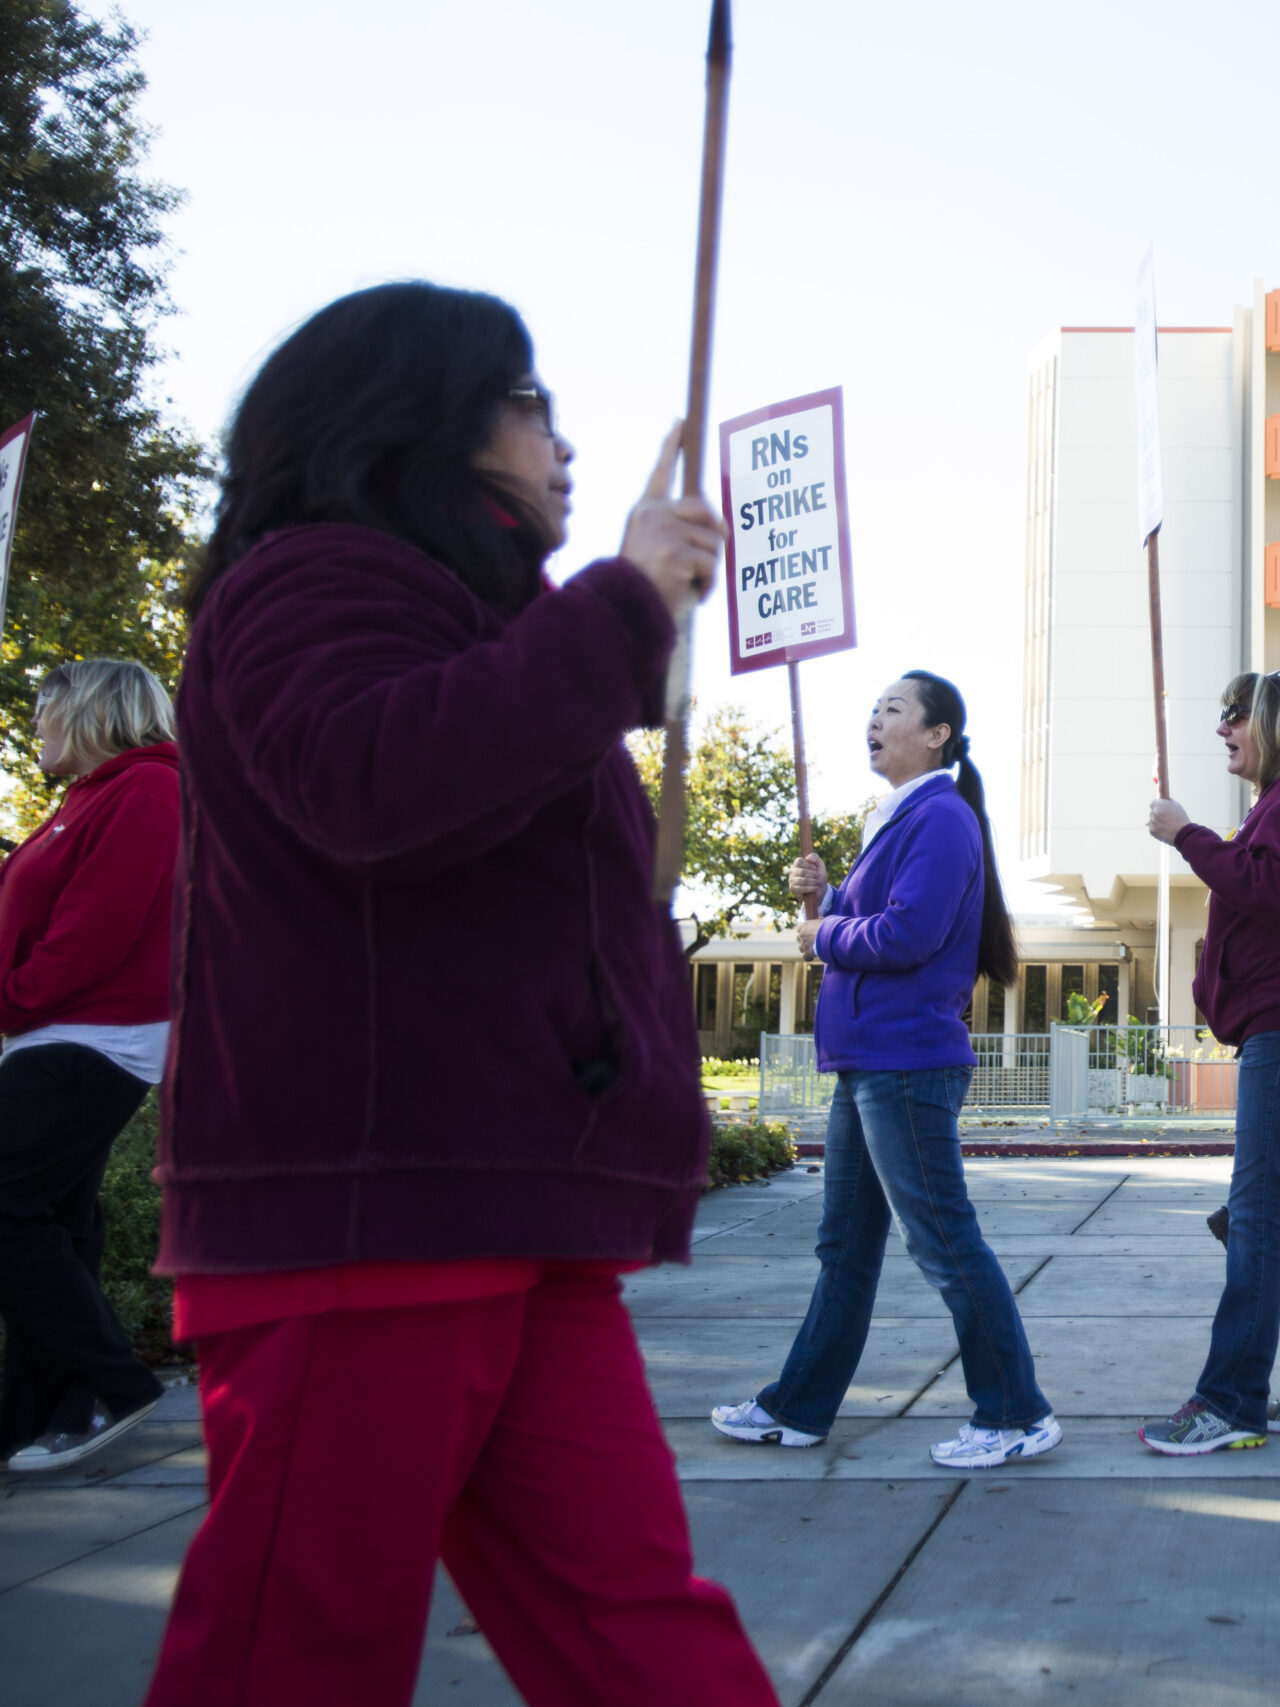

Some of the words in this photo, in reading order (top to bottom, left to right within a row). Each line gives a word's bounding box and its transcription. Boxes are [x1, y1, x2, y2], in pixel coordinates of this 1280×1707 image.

[752, 429, 809, 471] RNs
[767, 468, 791, 488] on
[740, 481, 827, 531] STRIKE
[768, 528, 797, 552] for
[741, 544, 832, 592] PATIENT
[758, 581, 818, 619] CARE
